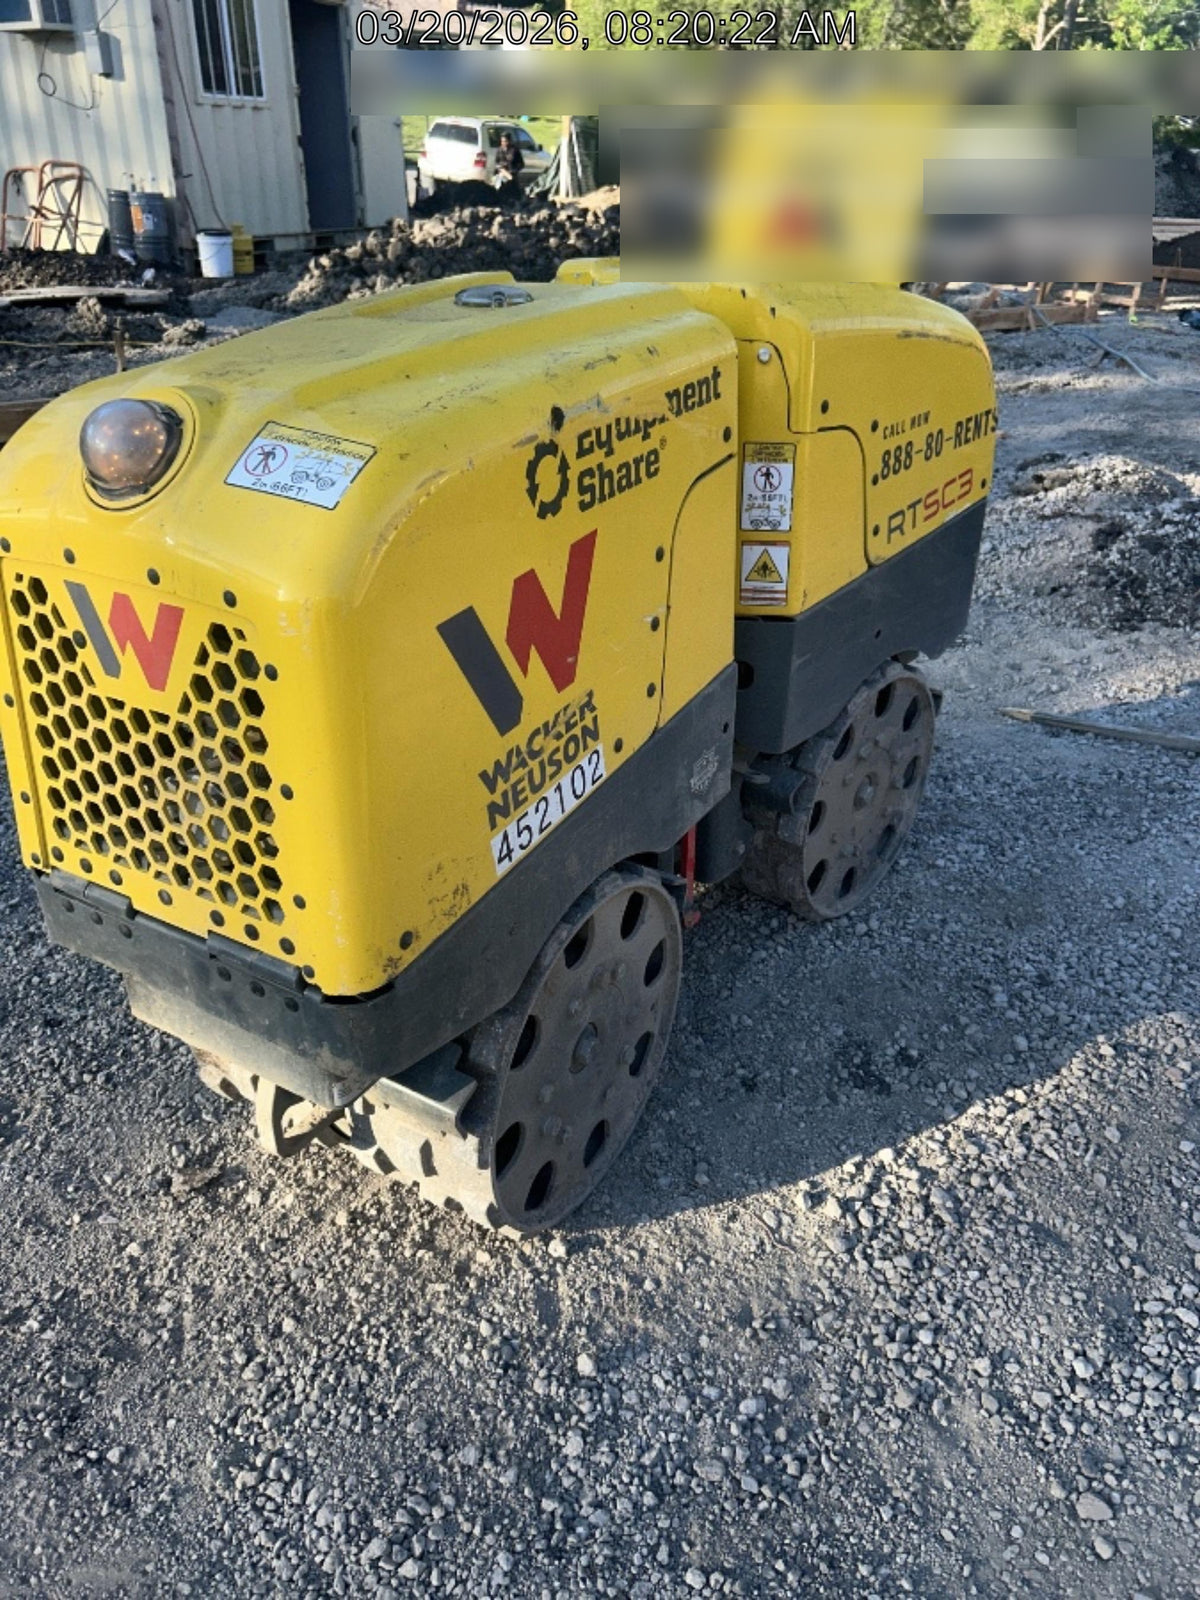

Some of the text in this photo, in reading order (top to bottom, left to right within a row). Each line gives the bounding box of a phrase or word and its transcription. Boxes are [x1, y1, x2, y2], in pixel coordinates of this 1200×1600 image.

[881, 407, 999, 481] 888-80-RENTS
[883, 420, 906, 440] CALL
[887, 467, 973, 544] RTSC3
[478, 688, 598, 796] WACKER
[486, 714, 601, 832] NEUSON
[496, 748, 604, 865] 452102
